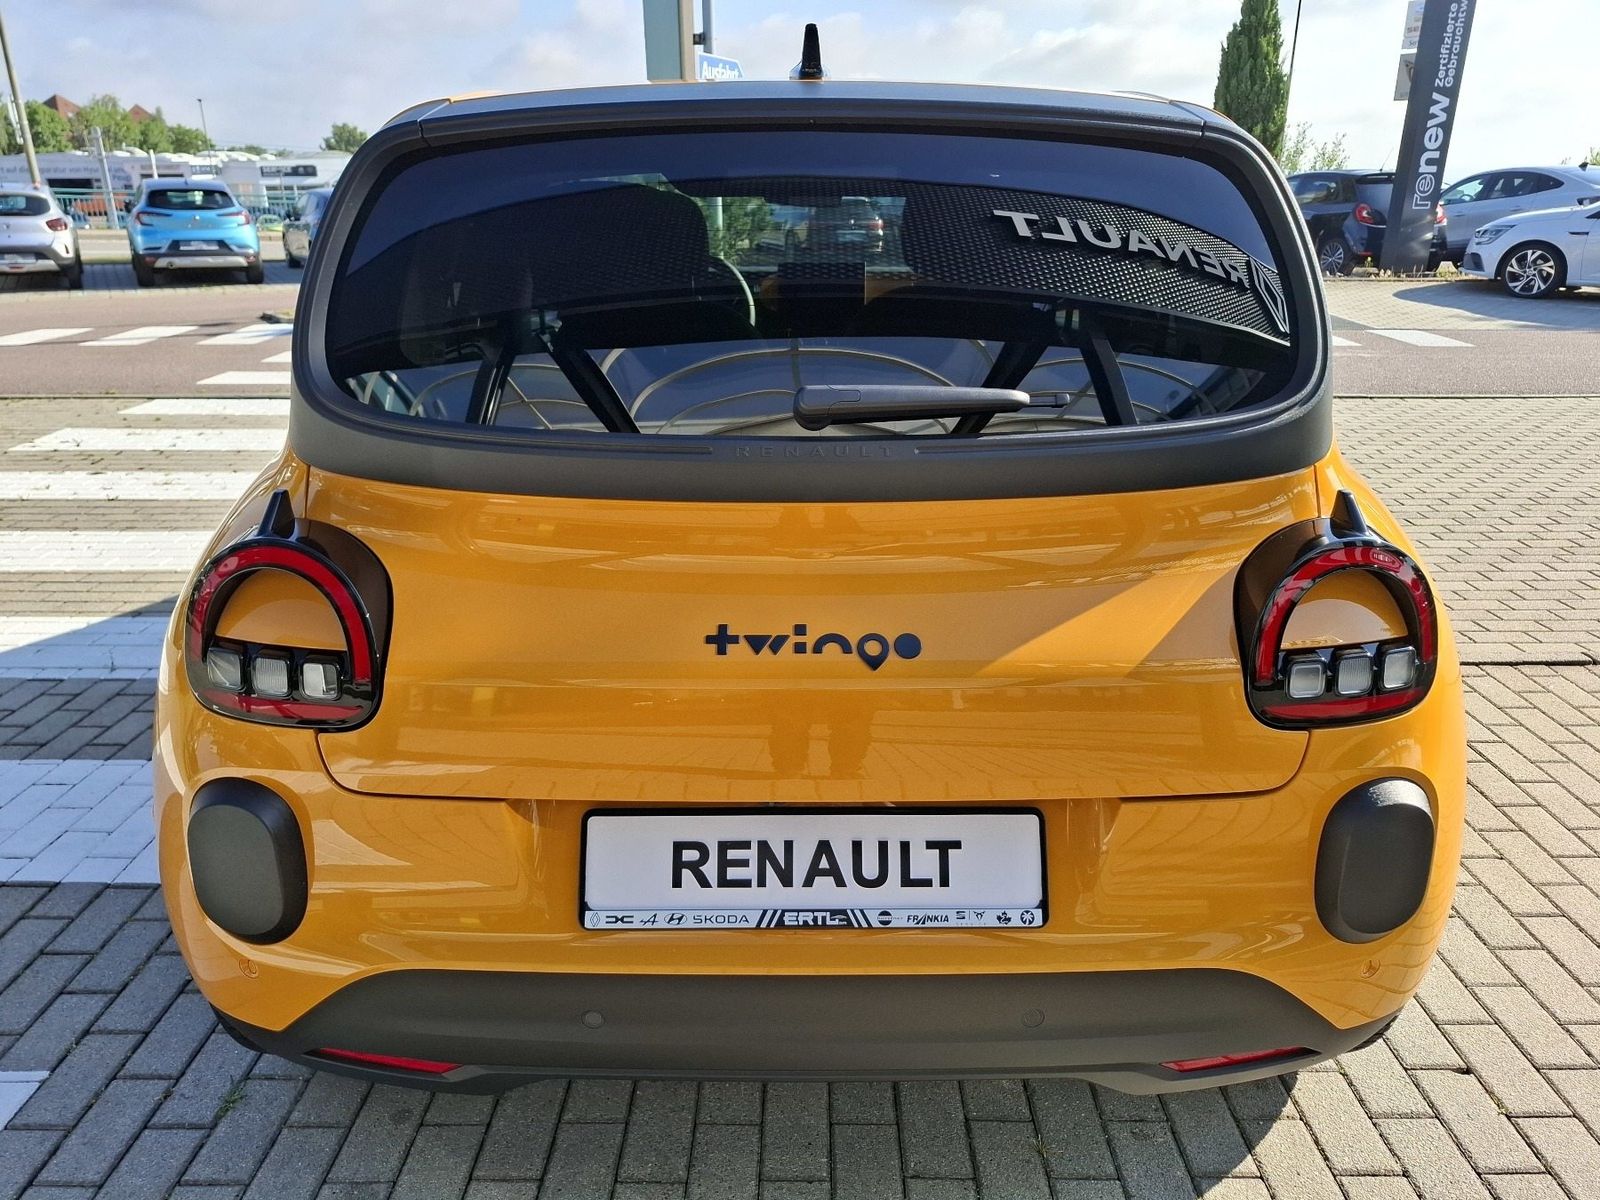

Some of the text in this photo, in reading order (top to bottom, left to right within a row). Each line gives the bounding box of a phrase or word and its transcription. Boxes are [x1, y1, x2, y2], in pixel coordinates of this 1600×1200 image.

[1435, 3, 1458, 87] Zertifizierte
[702, 61, 739, 79] Ausfahrt
[1412, 92, 1450, 209] renew
[736, 446, 892, 458] RENAULT
[705, 624, 922, 671] twingo
[671, 839, 962, 889] RENAULT
[907, 914, 949, 925] FRANKIA
